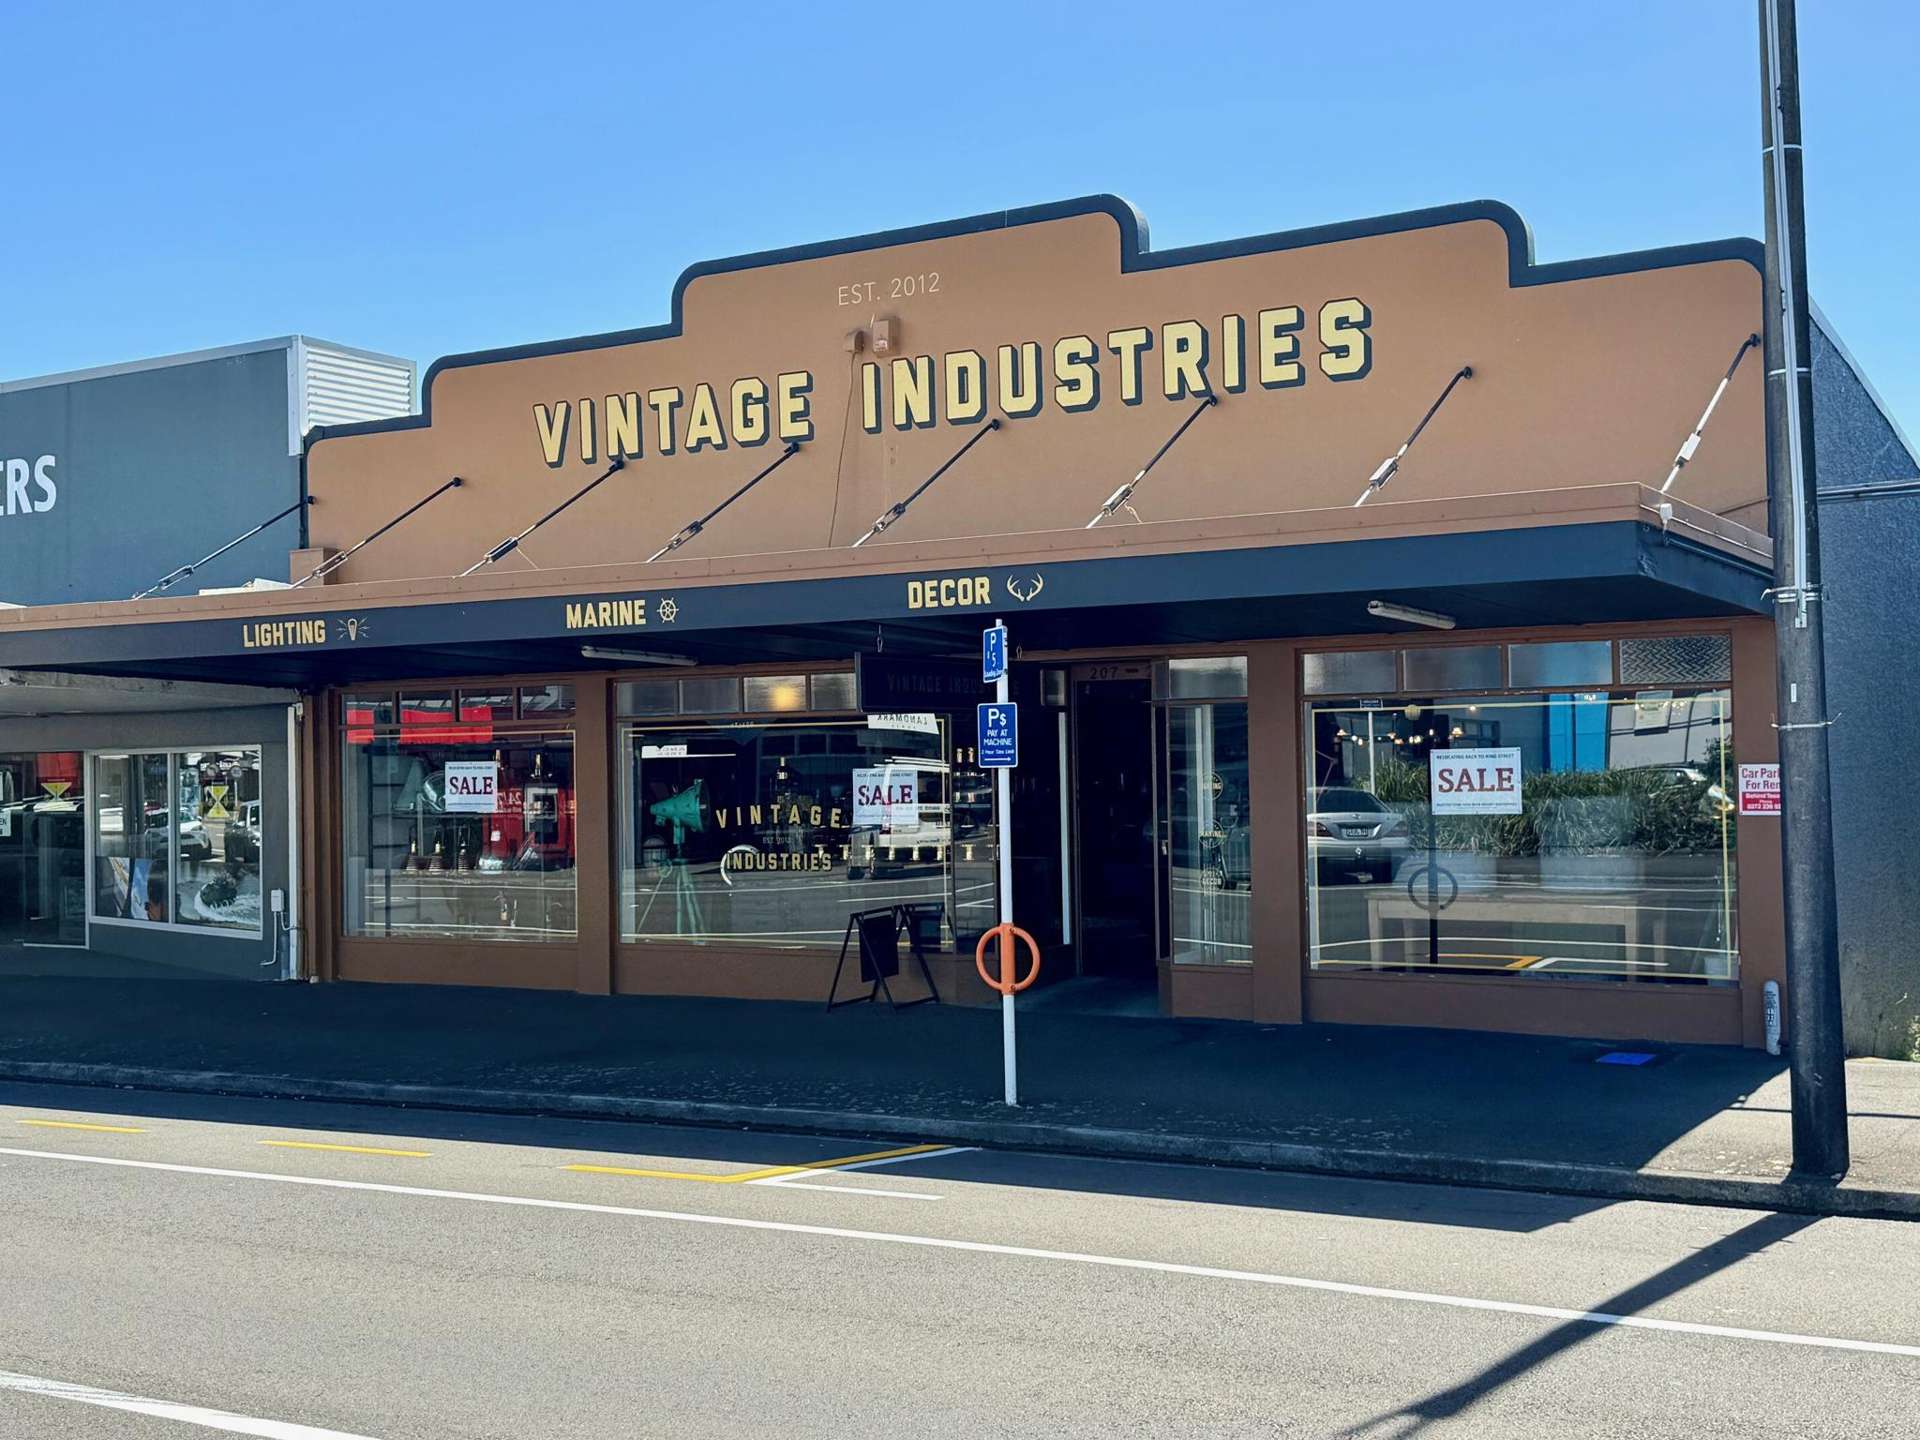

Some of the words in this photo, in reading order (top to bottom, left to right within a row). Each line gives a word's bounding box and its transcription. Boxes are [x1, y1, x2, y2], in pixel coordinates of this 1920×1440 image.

[838, 281, 880, 305] EST.
[891, 272, 940, 298] 2012
[533, 370, 813, 468] VINTAGE
[862, 297, 1371, 433] INDUSTRIES
[0, 454, 57, 516] RS
[908, 576, 991, 609] DECOR
[566, 599, 647, 629] MARINE
[243, 620, 326, 648] LIGHTING
[984, 738, 1012, 746] MACHINE
[987, 729, 998, 737] PAY
[1438, 767, 1515, 793] SALE
[1742, 768, 1759, 778] Car
[1746, 780, 1761, 789] For
[1763, 780, 1780, 789] Ren
[449, 776, 494, 795] SALE
[858, 784, 913, 806] SALE
[716, 804, 842, 828] VINTAGE
[727, 852, 832, 871] INDUSTRIES
